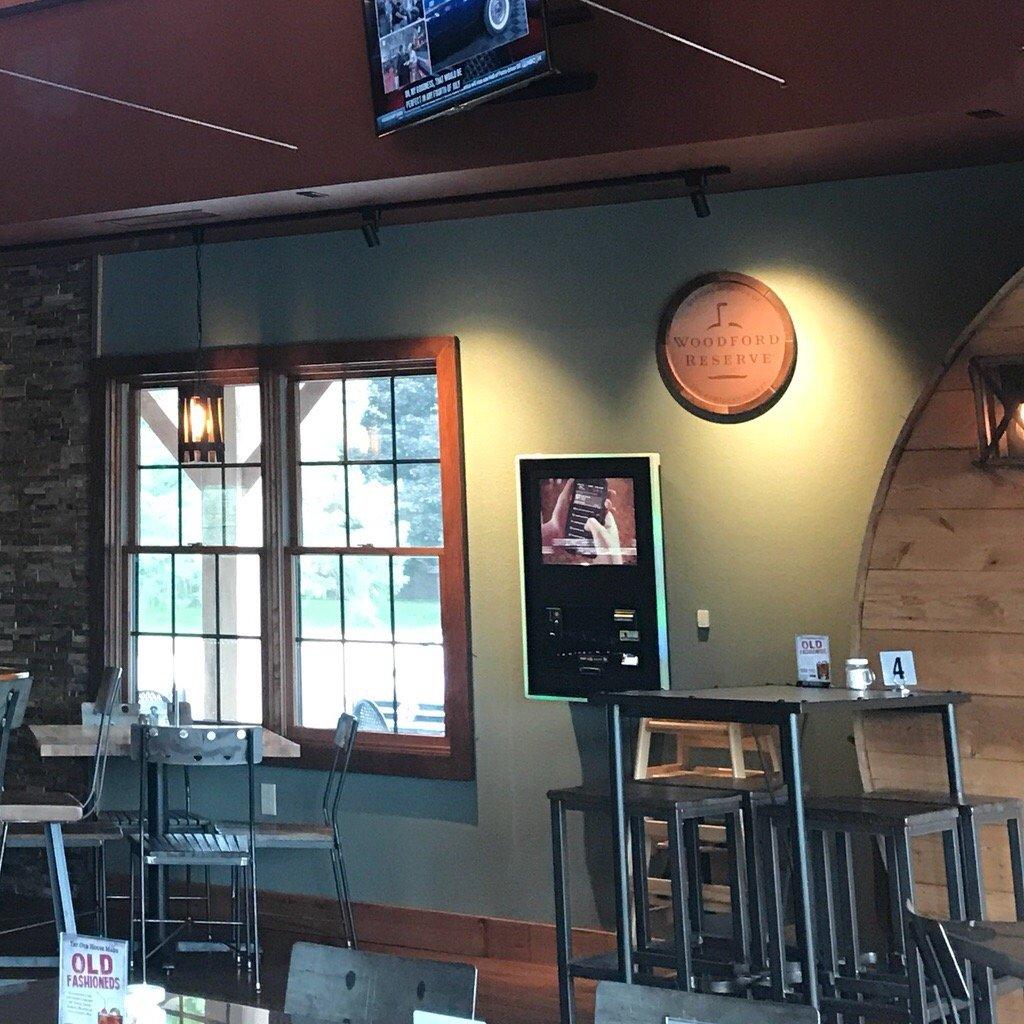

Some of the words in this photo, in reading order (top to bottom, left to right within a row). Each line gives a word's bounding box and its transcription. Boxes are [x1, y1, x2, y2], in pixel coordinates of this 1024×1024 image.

[674, 334, 780, 349] WOODFORD
[686, 353, 772, 367] RESERVE
[801, 640, 822, 649] OLD
[893, 657, 904, 679] 4
[71, 952, 113, 975] OLD
[67, 974, 120, 990] FASHIONEDS
